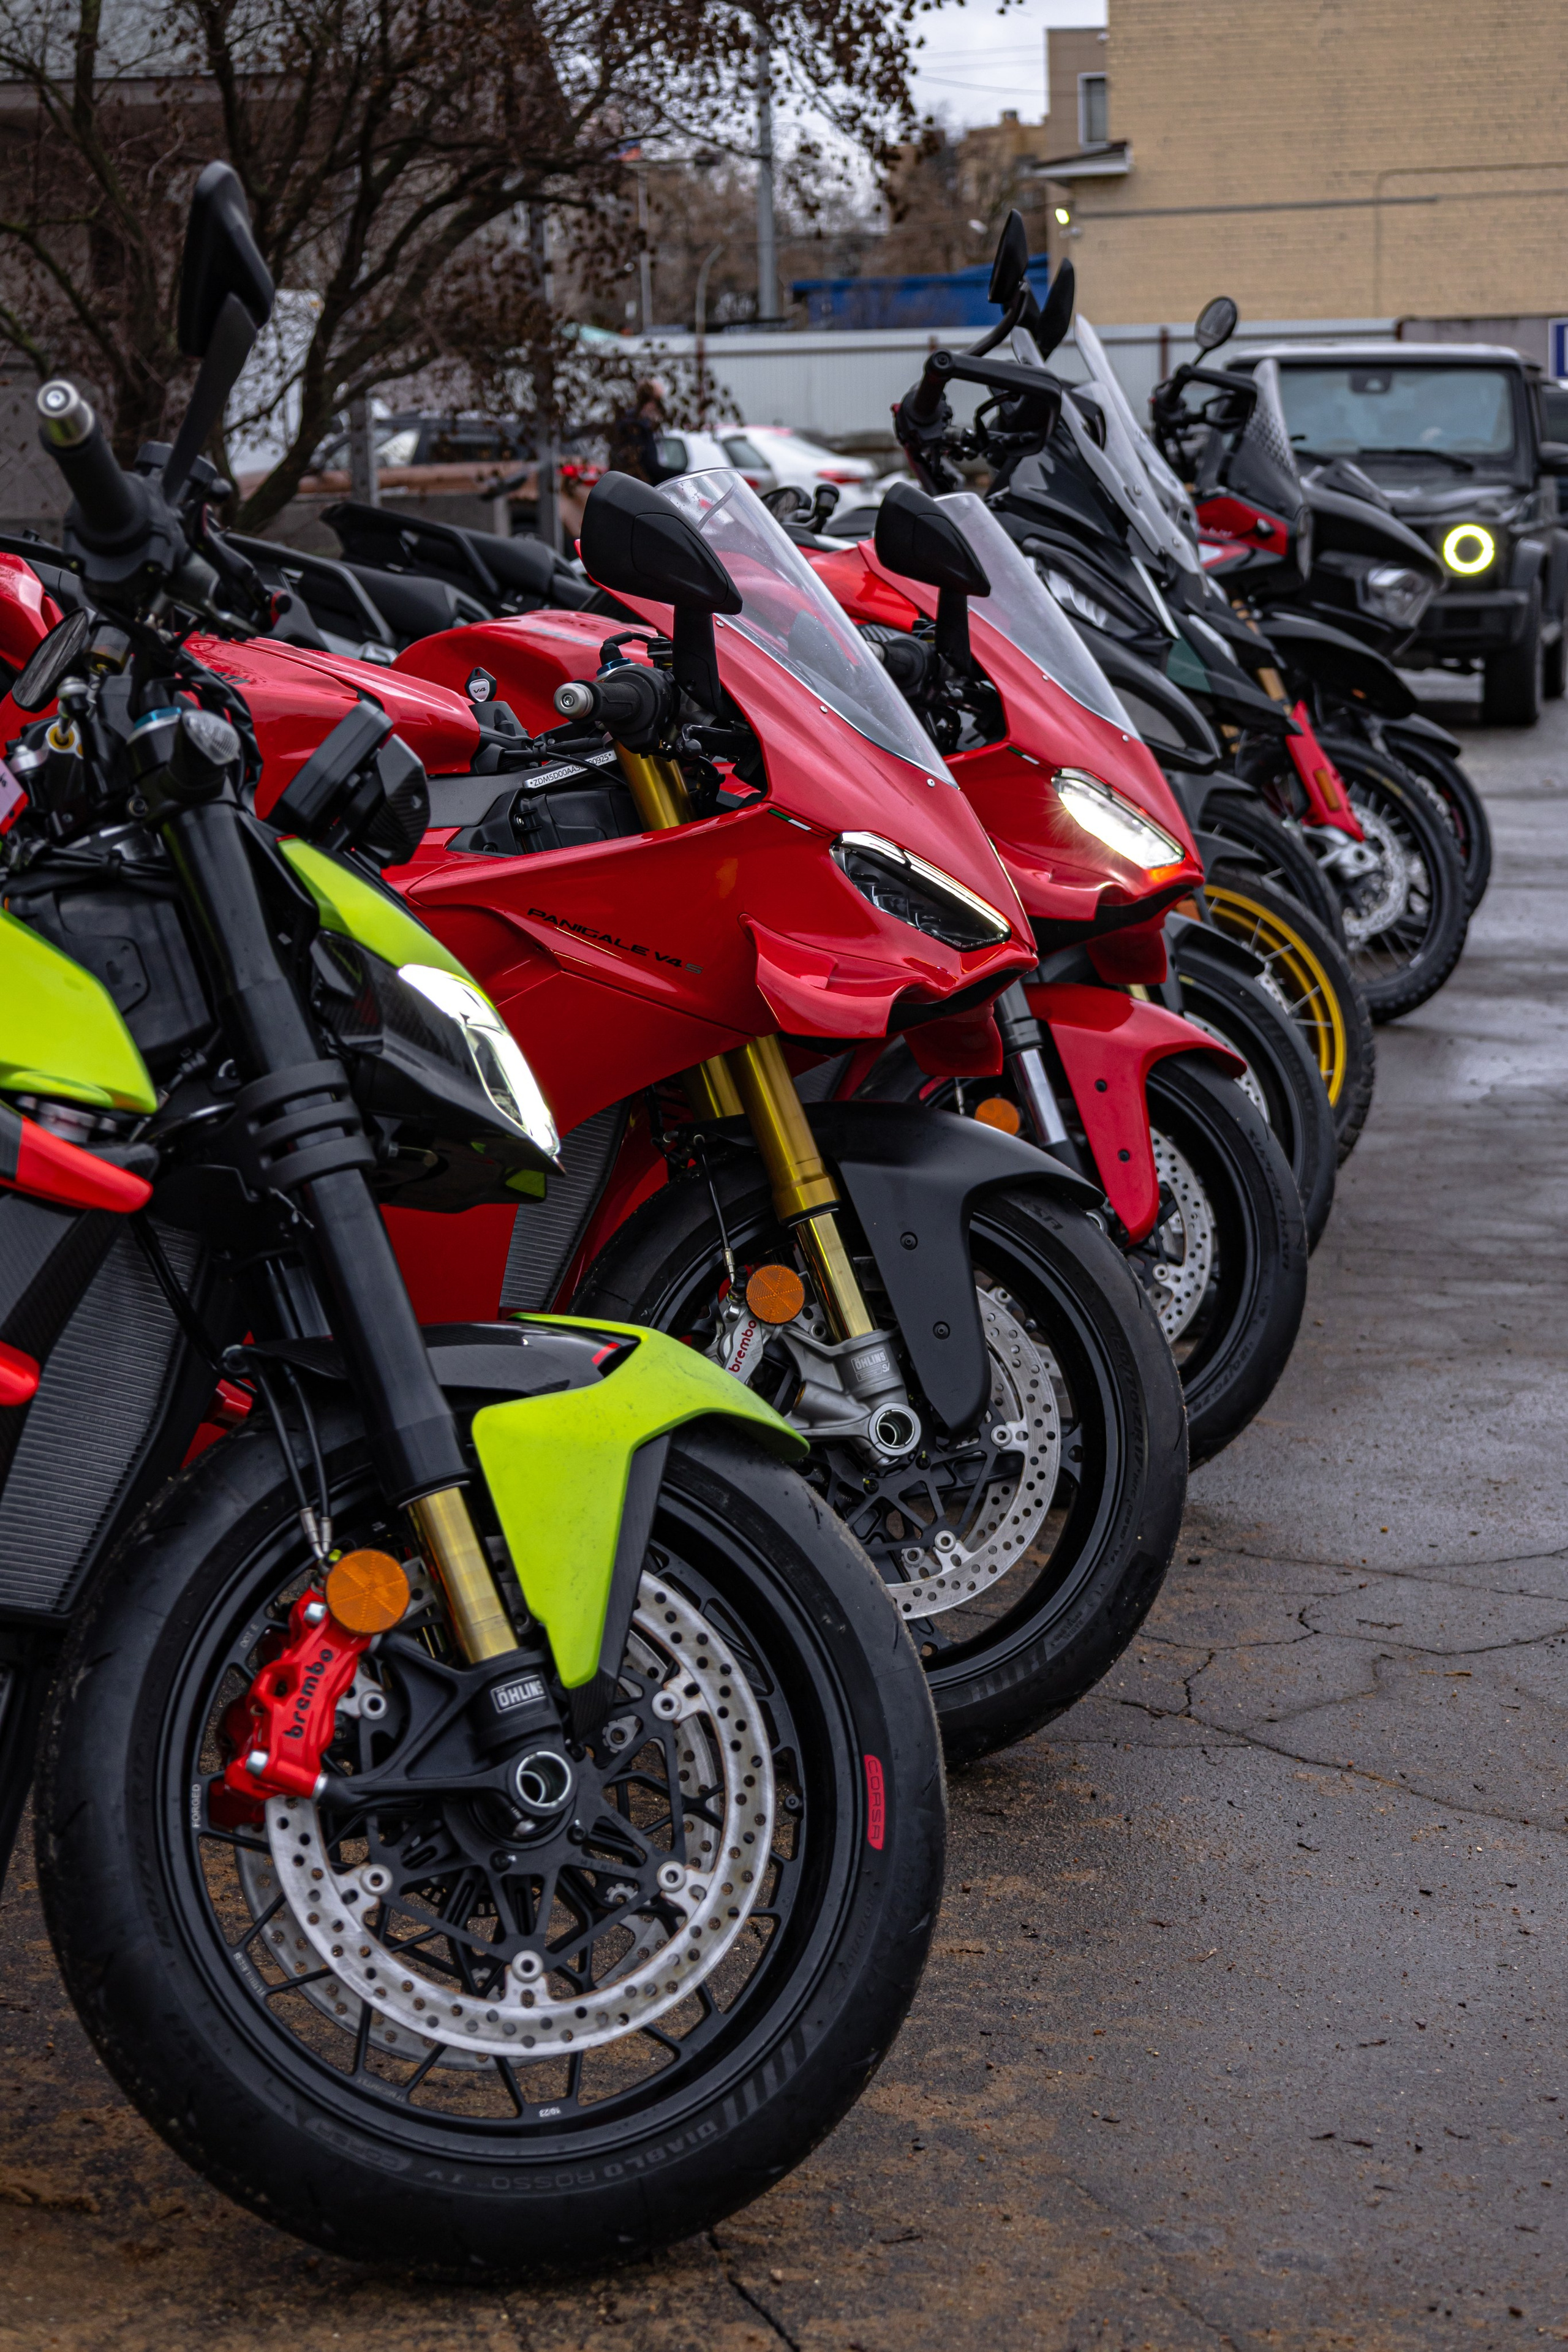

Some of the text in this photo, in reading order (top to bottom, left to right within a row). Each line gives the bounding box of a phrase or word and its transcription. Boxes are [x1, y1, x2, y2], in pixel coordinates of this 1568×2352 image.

[527, 908, 649, 957] PANIGALE
[728, 1320, 756, 1373] brembo
[854, 1352, 886, 1370] ÖHLINS
[283, 1648, 333, 1738] brembo
[496, 1680, 545, 1707] ÖHLINS
[192, 1784, 201, 1828] FORGED
[868, 1760, 881, 1839] CORSA
[423, 2117, 717, 2189] DIABLO ROSSO IV
